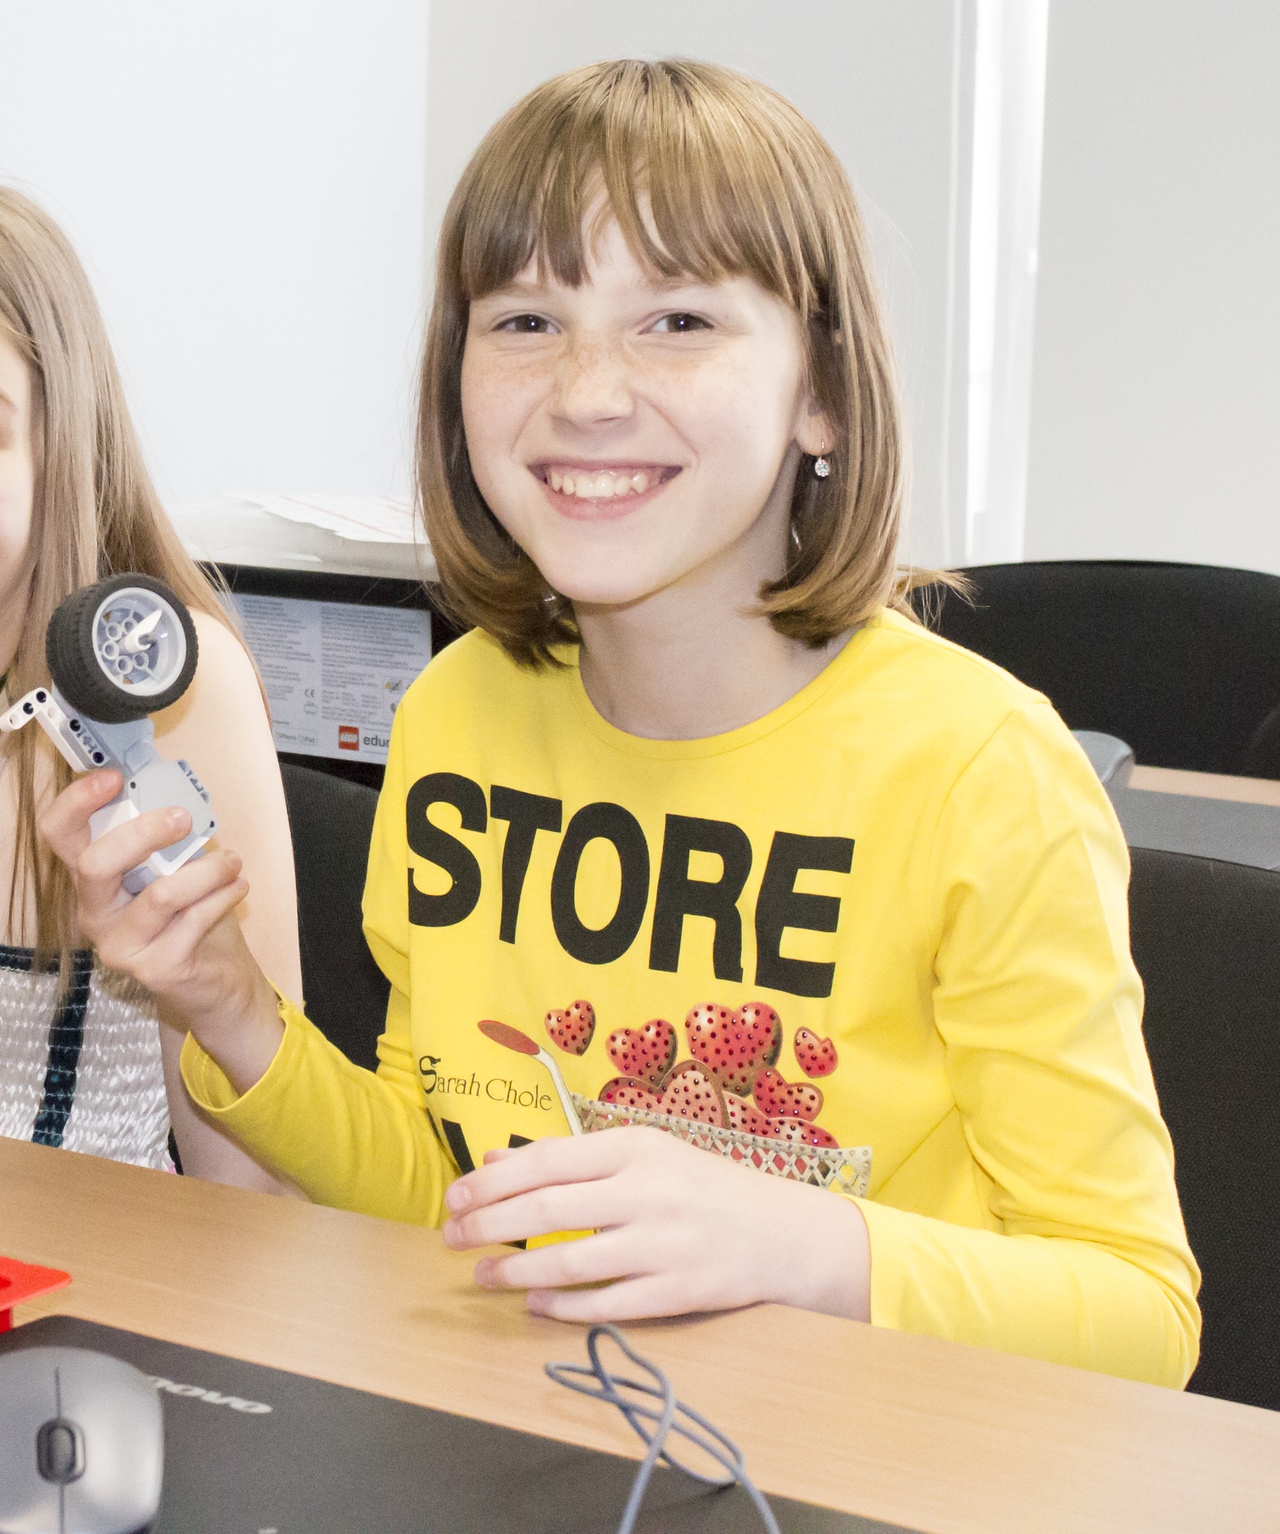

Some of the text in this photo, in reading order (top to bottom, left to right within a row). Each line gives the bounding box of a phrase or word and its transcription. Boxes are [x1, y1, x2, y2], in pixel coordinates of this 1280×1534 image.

[405, 772, 855, 998] STORE
[419, 1055, 553, 1111] Sarah Chole
